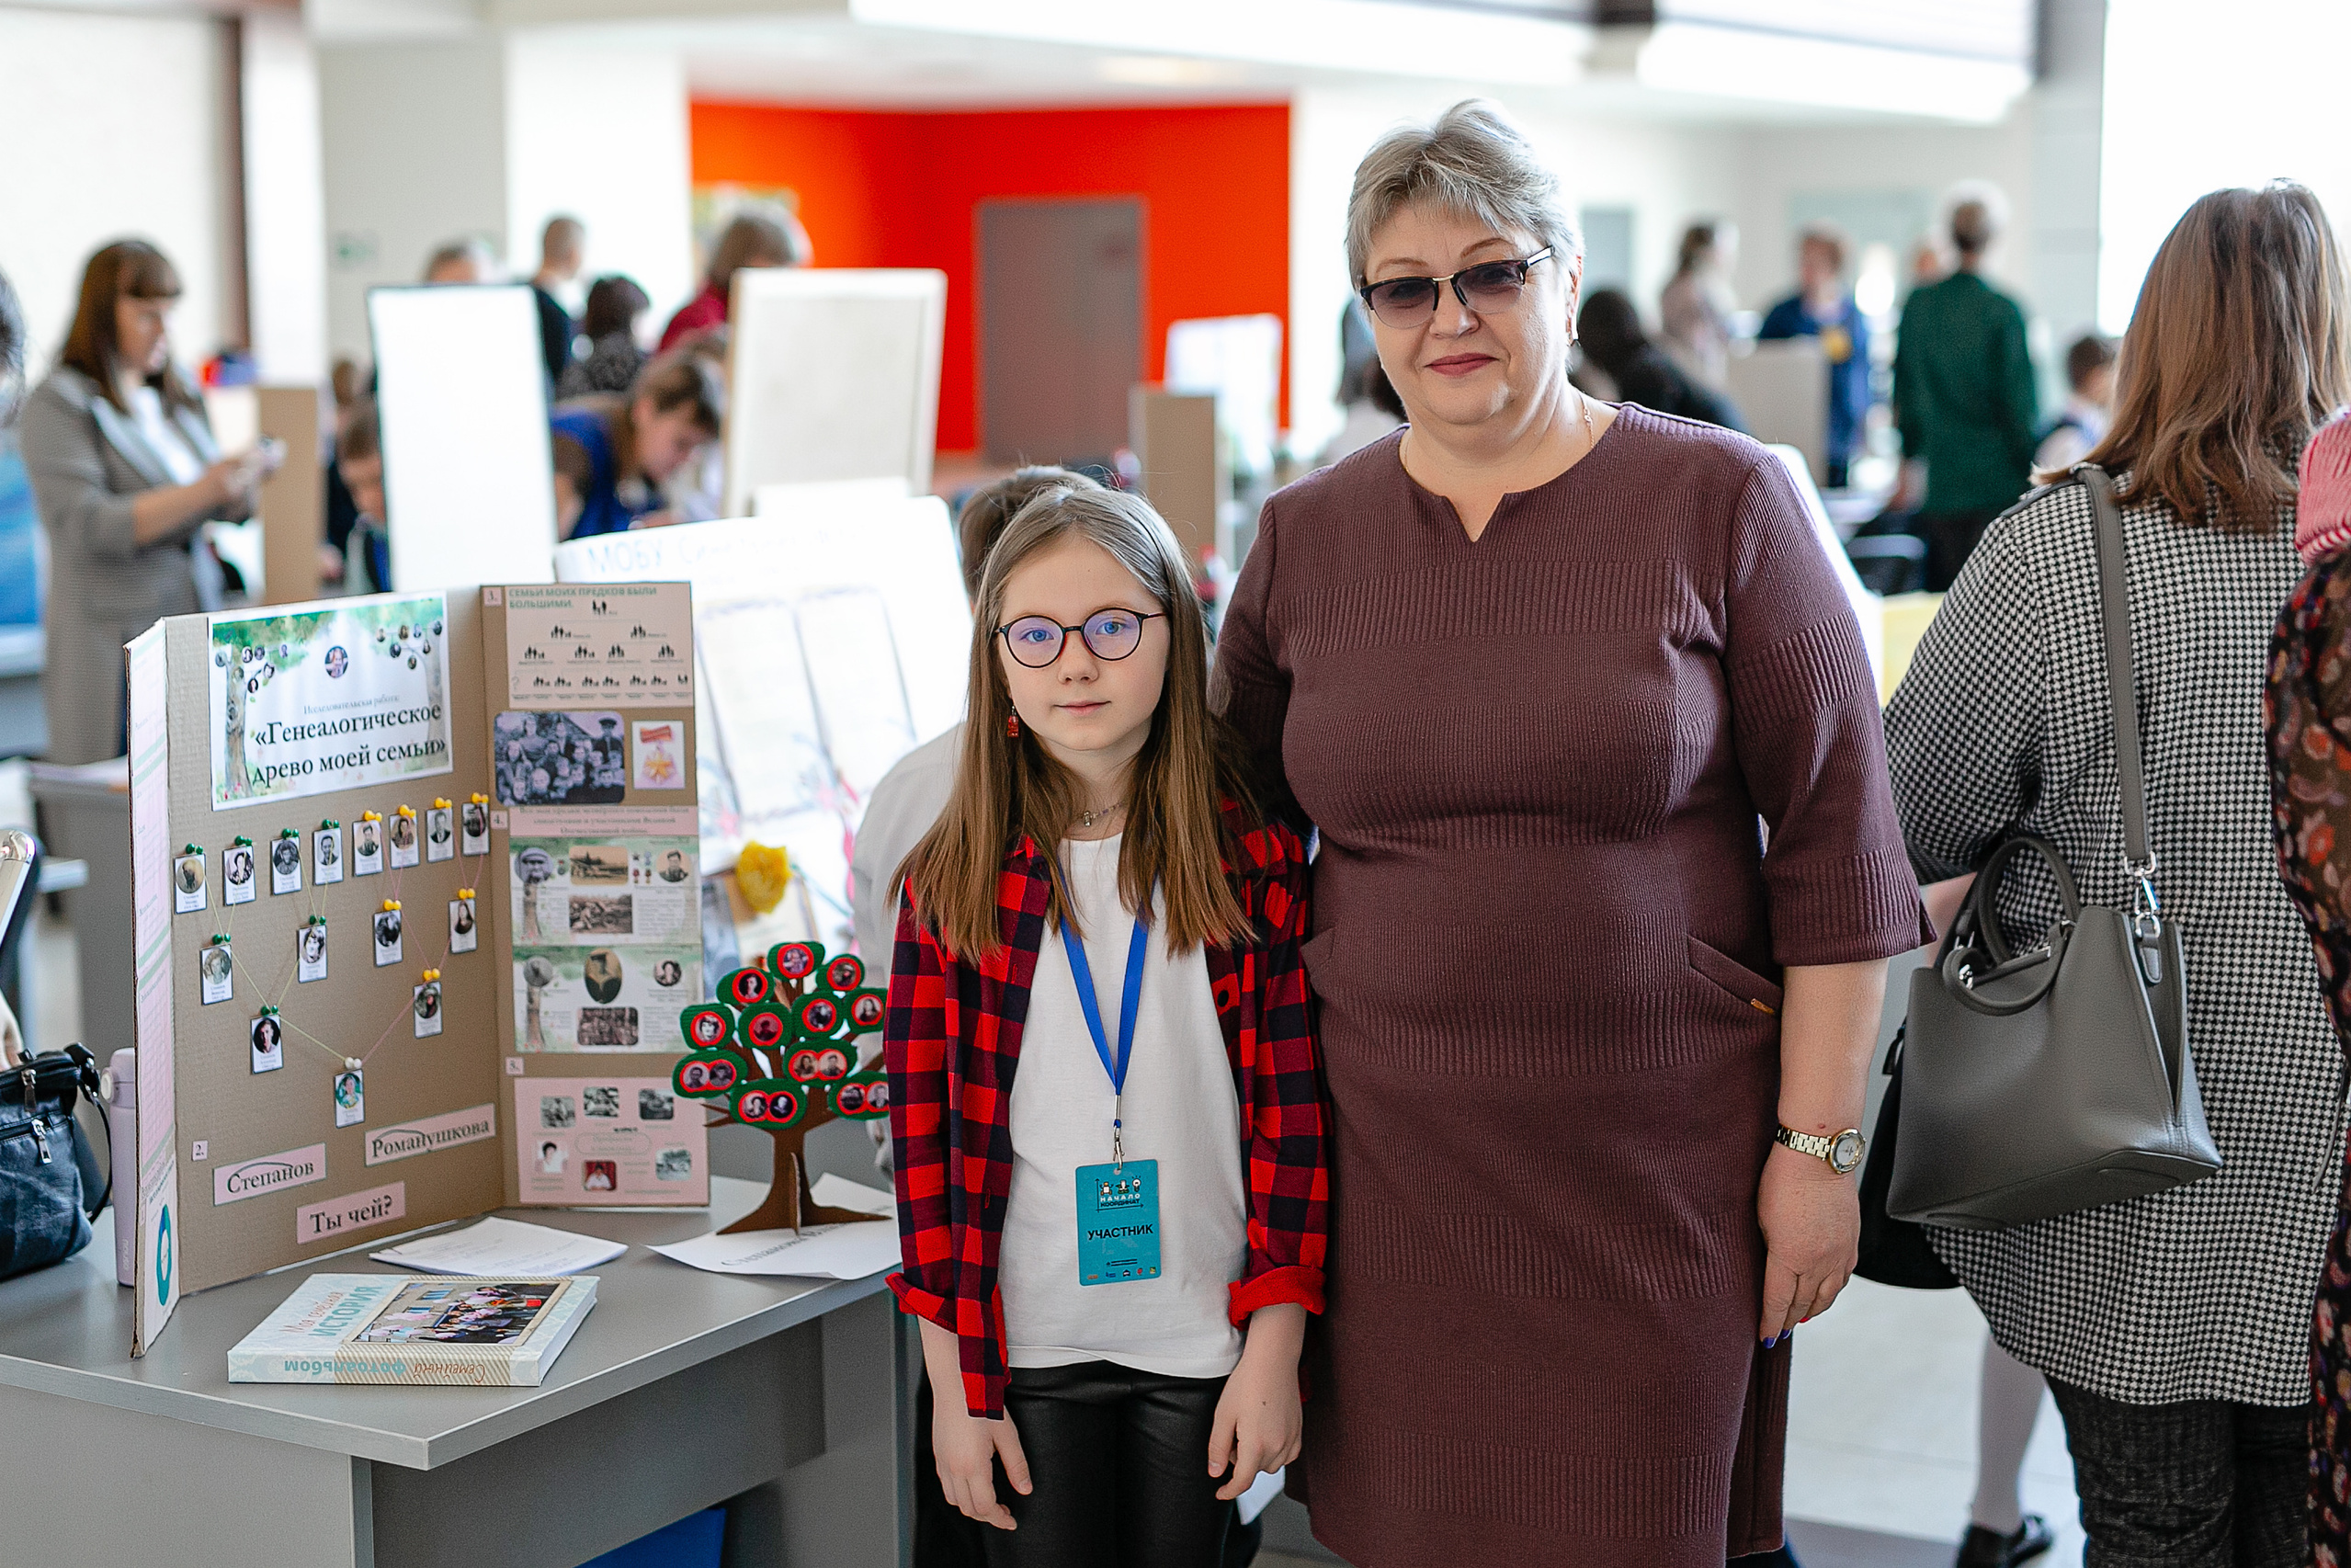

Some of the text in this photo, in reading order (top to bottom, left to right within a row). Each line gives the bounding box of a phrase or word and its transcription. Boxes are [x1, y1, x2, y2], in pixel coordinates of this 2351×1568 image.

[508, 586, 657, 597] СЕМЬИ МОИХ ПРЕДКОВ БЫЛИ
[508, 599, 574, 609] БОЛЬШИМИ.
[255, 704, 442, 745] «Генеалогическое
[253, 737, 447, 789] древо моей семьи»
[371, 1119, 490, 1158] Романушкова
[226, 1162, 314, 1194] Степанов
[1100, 1193, 1141, 1202] НАЧАЛО
[1100, 1199, 1141, 1208] КООРДИНАТ
[309, 1195, 393, 1233] Ты чей?
[1087, 1223, 1154, 1241] УЧАСТНИК
[308, 1286, 383, 1336] ИСТОРИЯ
[284, 1358, 486, 1383] Семейный фотоальбом
